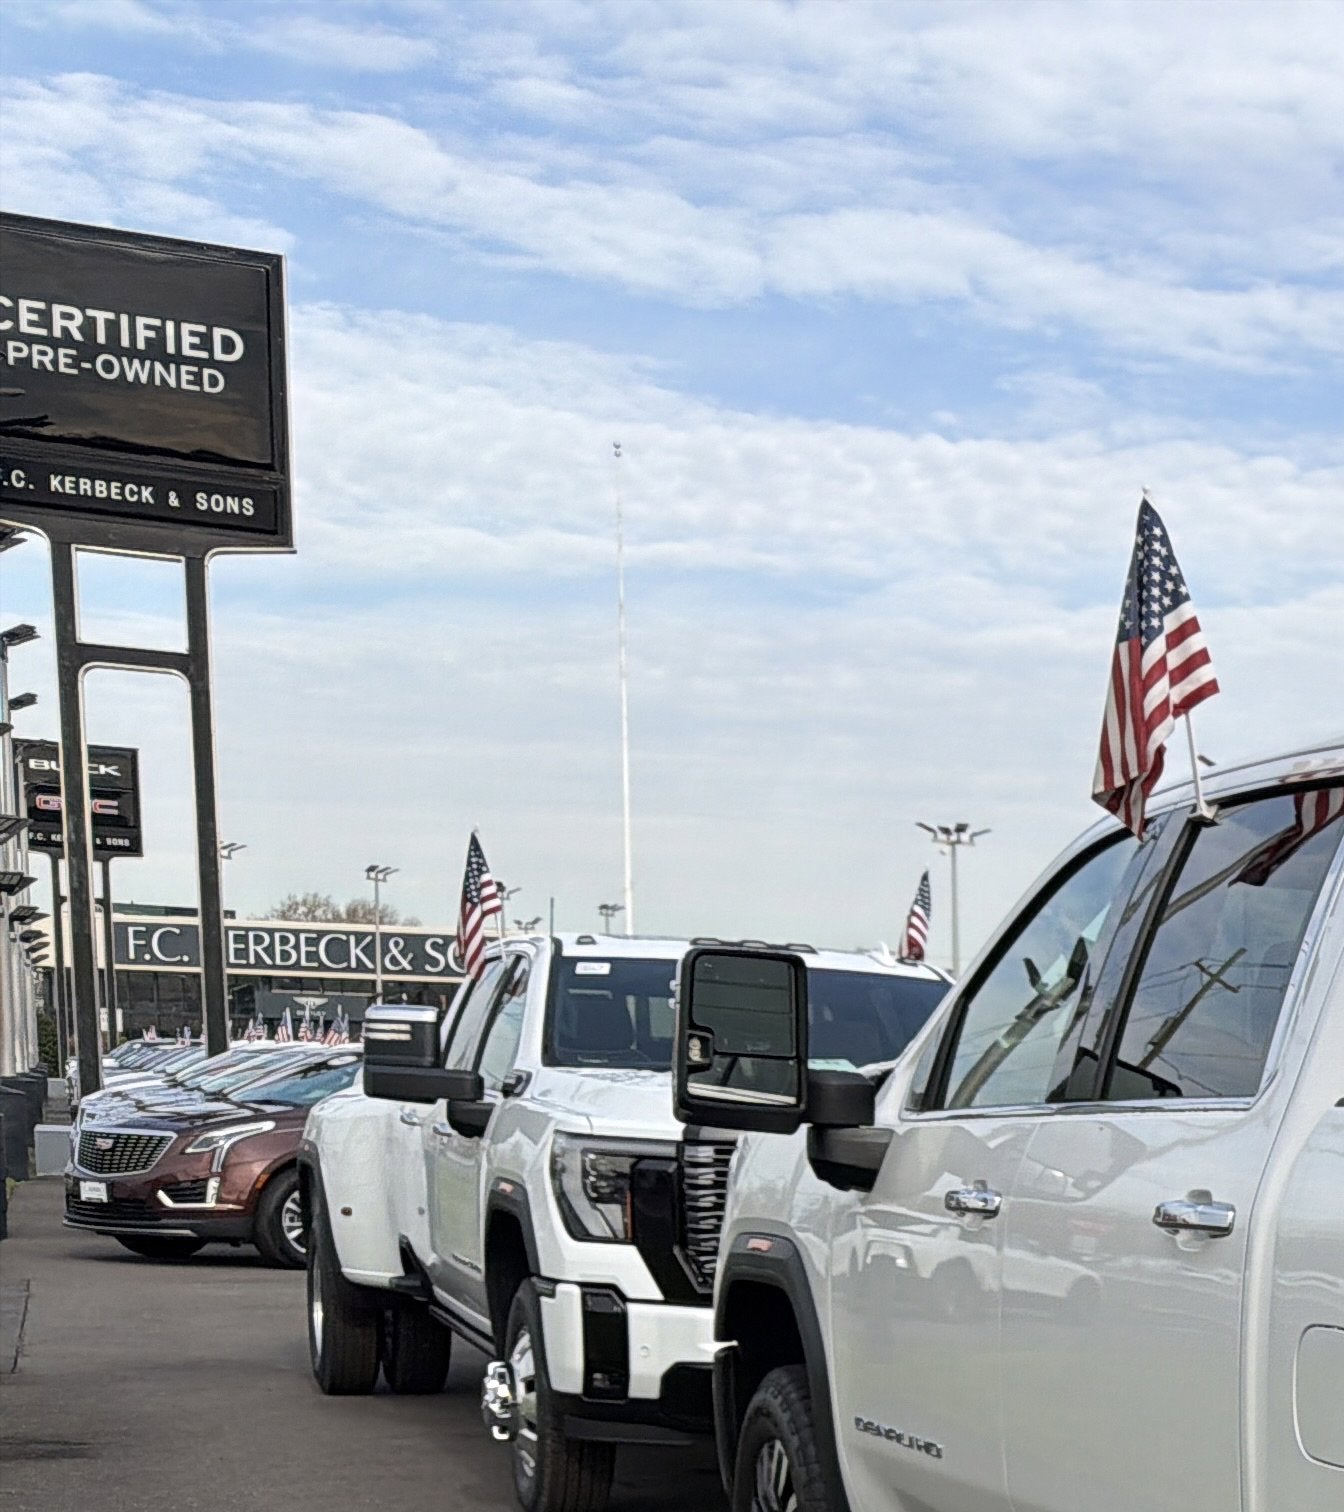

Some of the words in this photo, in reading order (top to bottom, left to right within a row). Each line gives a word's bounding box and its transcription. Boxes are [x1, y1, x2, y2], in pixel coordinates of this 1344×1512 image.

[6, 341, 225, 394] PRE-OWNED
[0, 468, 34, 489] .C.
[50, 474, 154, 504] KERBECK
[168, 491, 180, 508] &
[196, 493, 254, 516] SONS
[28, 758, 121, 776] BUCK
[36, 794, 119, 815] GC
[128, 926, 189, 962] F.C.
[227, 930, 375, 970] ERBECK
[384, 936, 413, 971] &
[424, 938, 466, 973] SO
